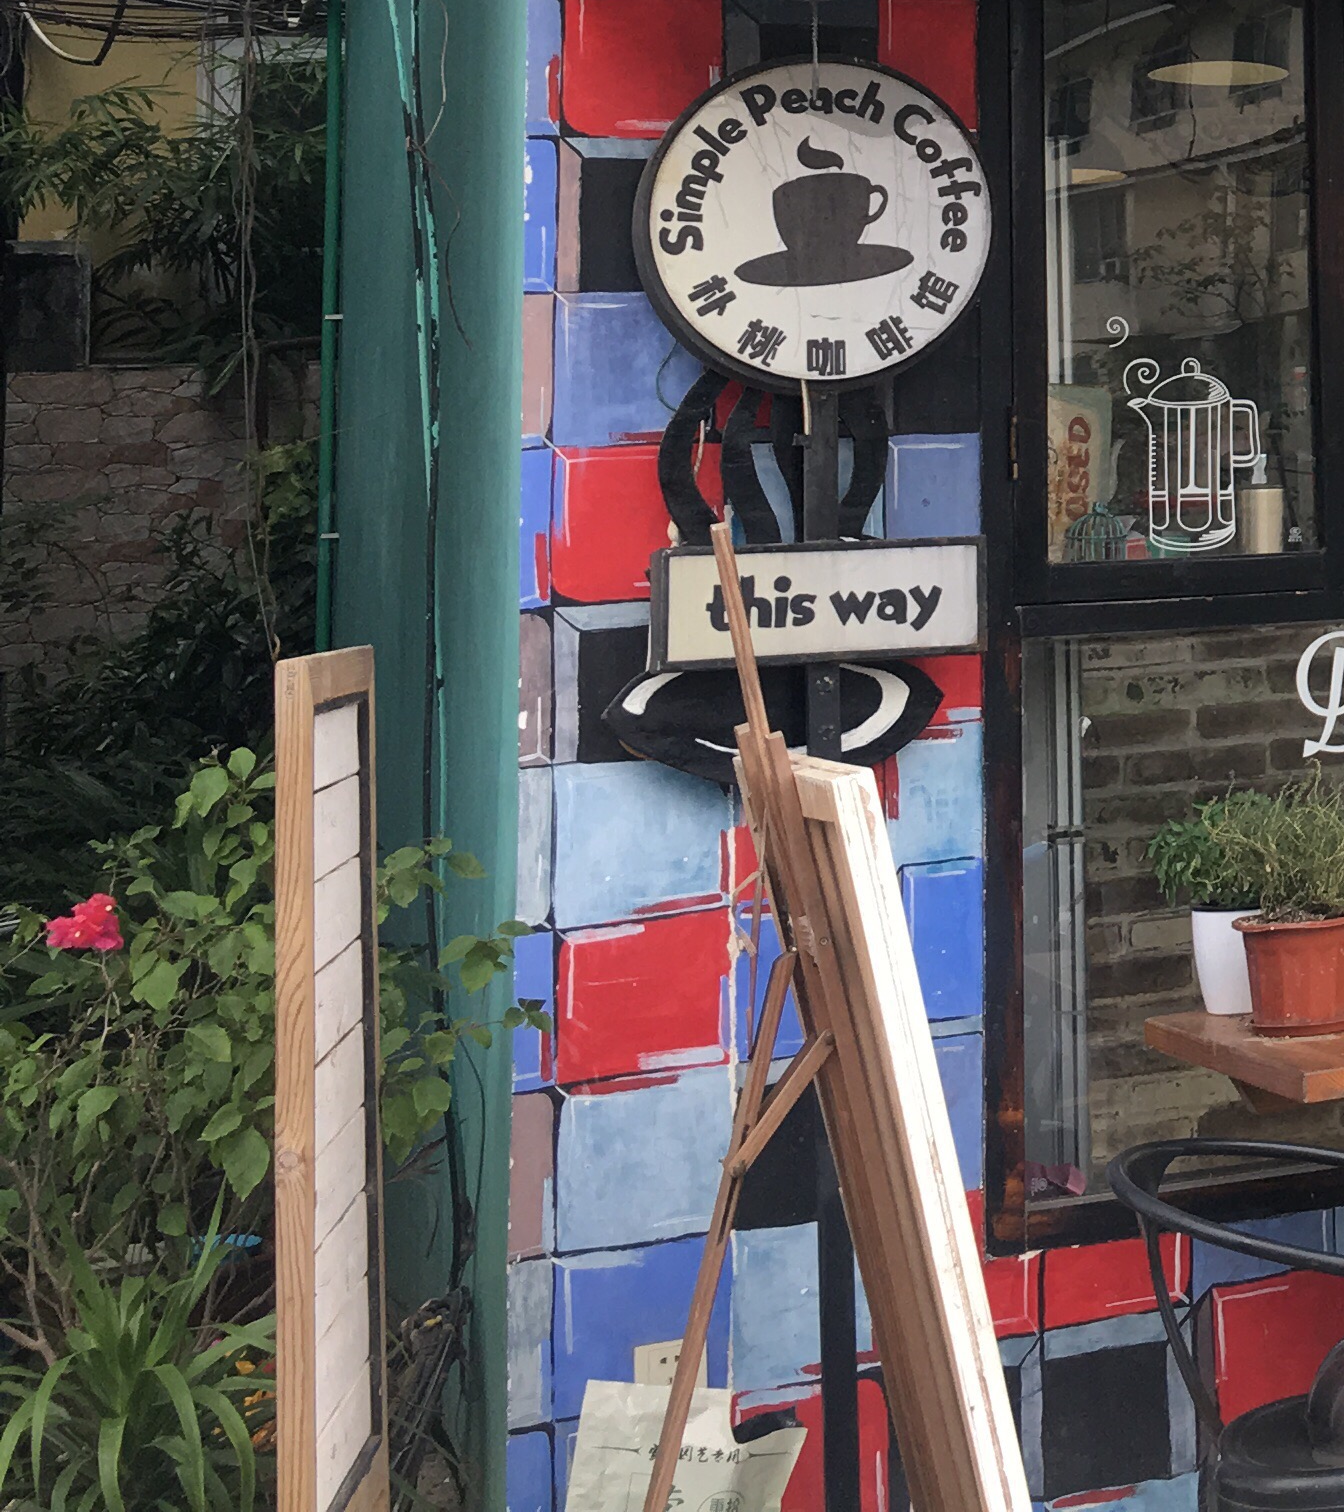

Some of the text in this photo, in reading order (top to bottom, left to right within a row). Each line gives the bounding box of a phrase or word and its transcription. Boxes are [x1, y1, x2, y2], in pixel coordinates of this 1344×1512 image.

[658, 80, 983, 256] Simple Peach Coffee
[686, 270, 960, 377] 朴桃咖啡馆
[706, 574, 944, 633] this way
